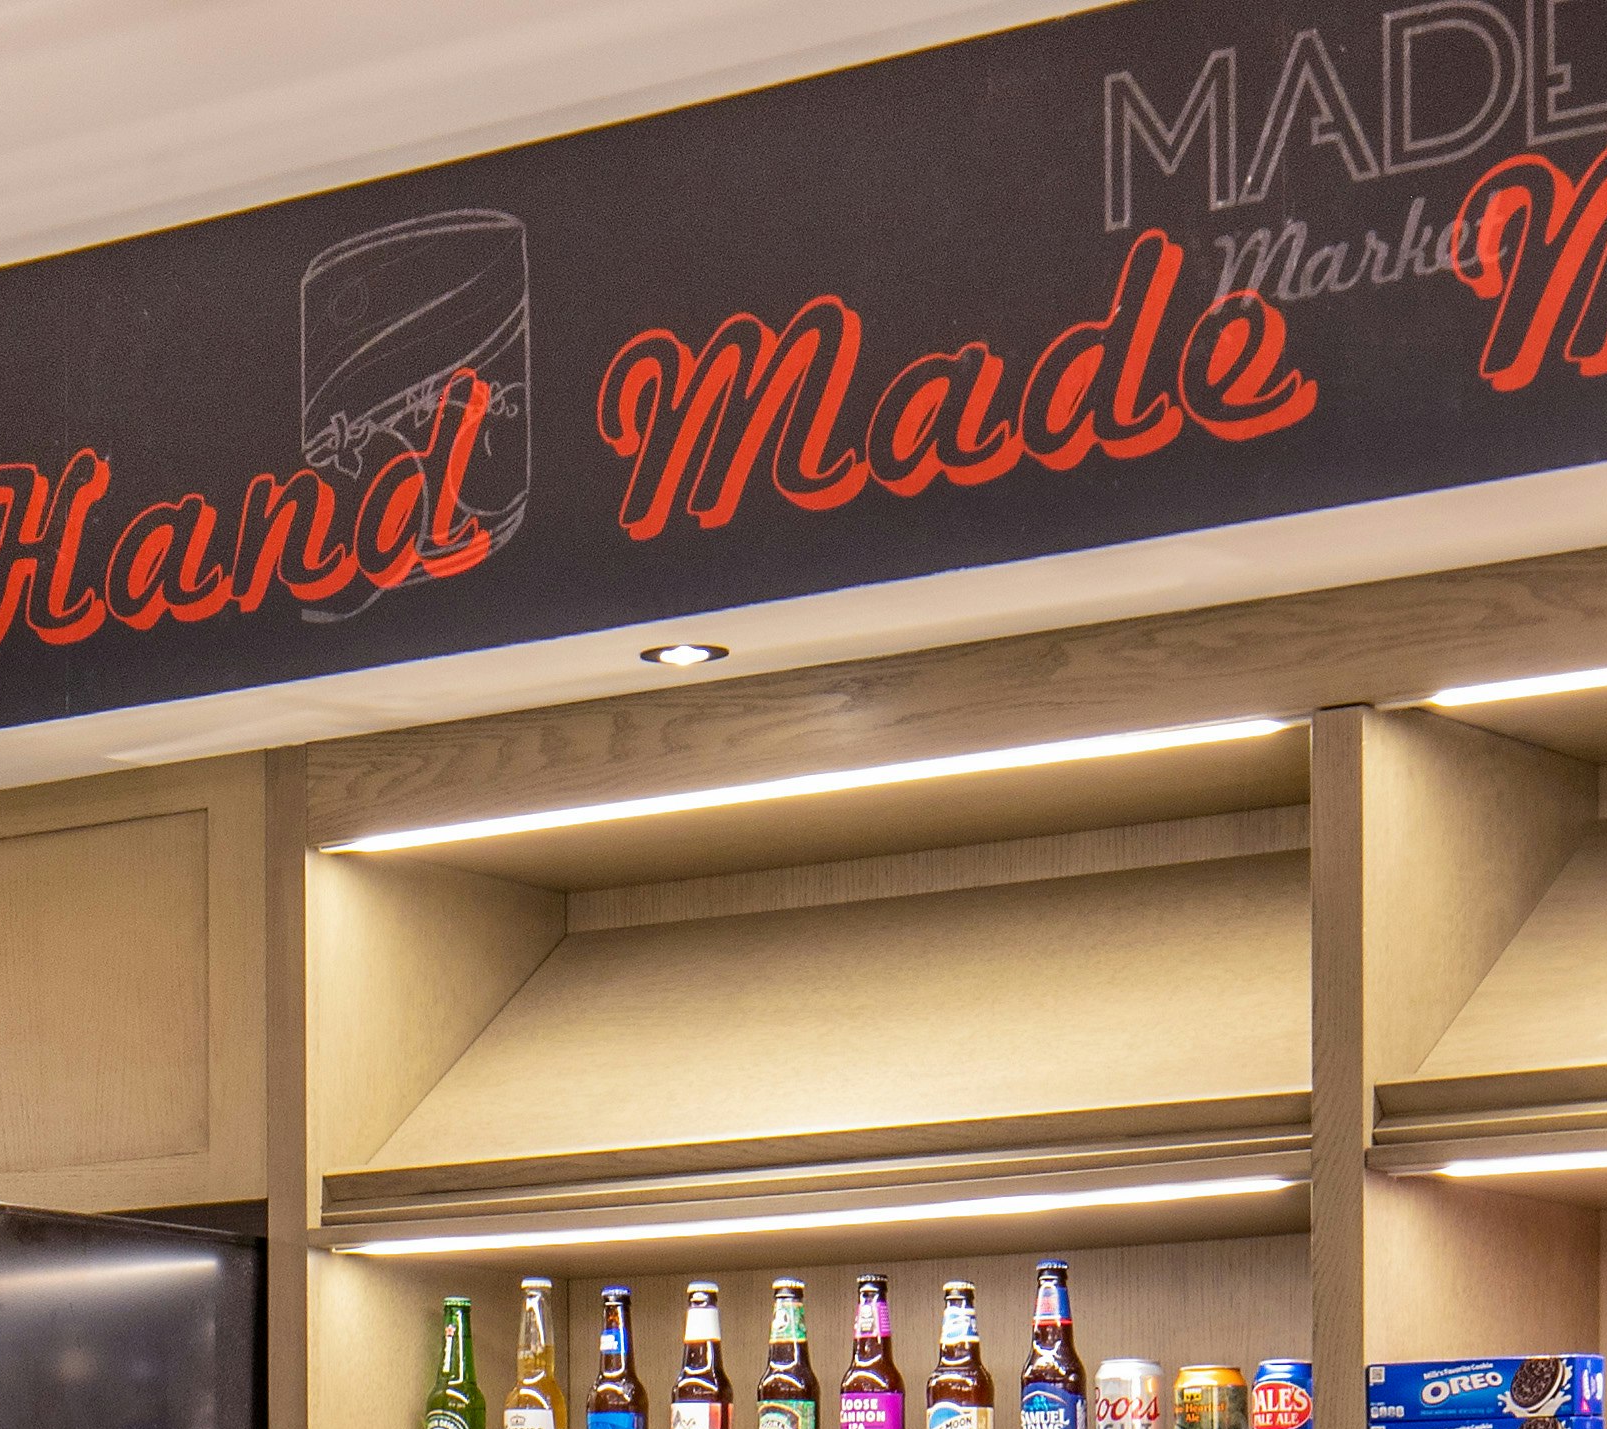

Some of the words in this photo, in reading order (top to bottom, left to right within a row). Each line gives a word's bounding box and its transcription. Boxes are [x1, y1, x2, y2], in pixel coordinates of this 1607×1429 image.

[596, 226, 1318, 544] Made
[1419, 1372, 1504, 1407] OREO
[1021, 1408, 1071, 1429] SAMUEL
